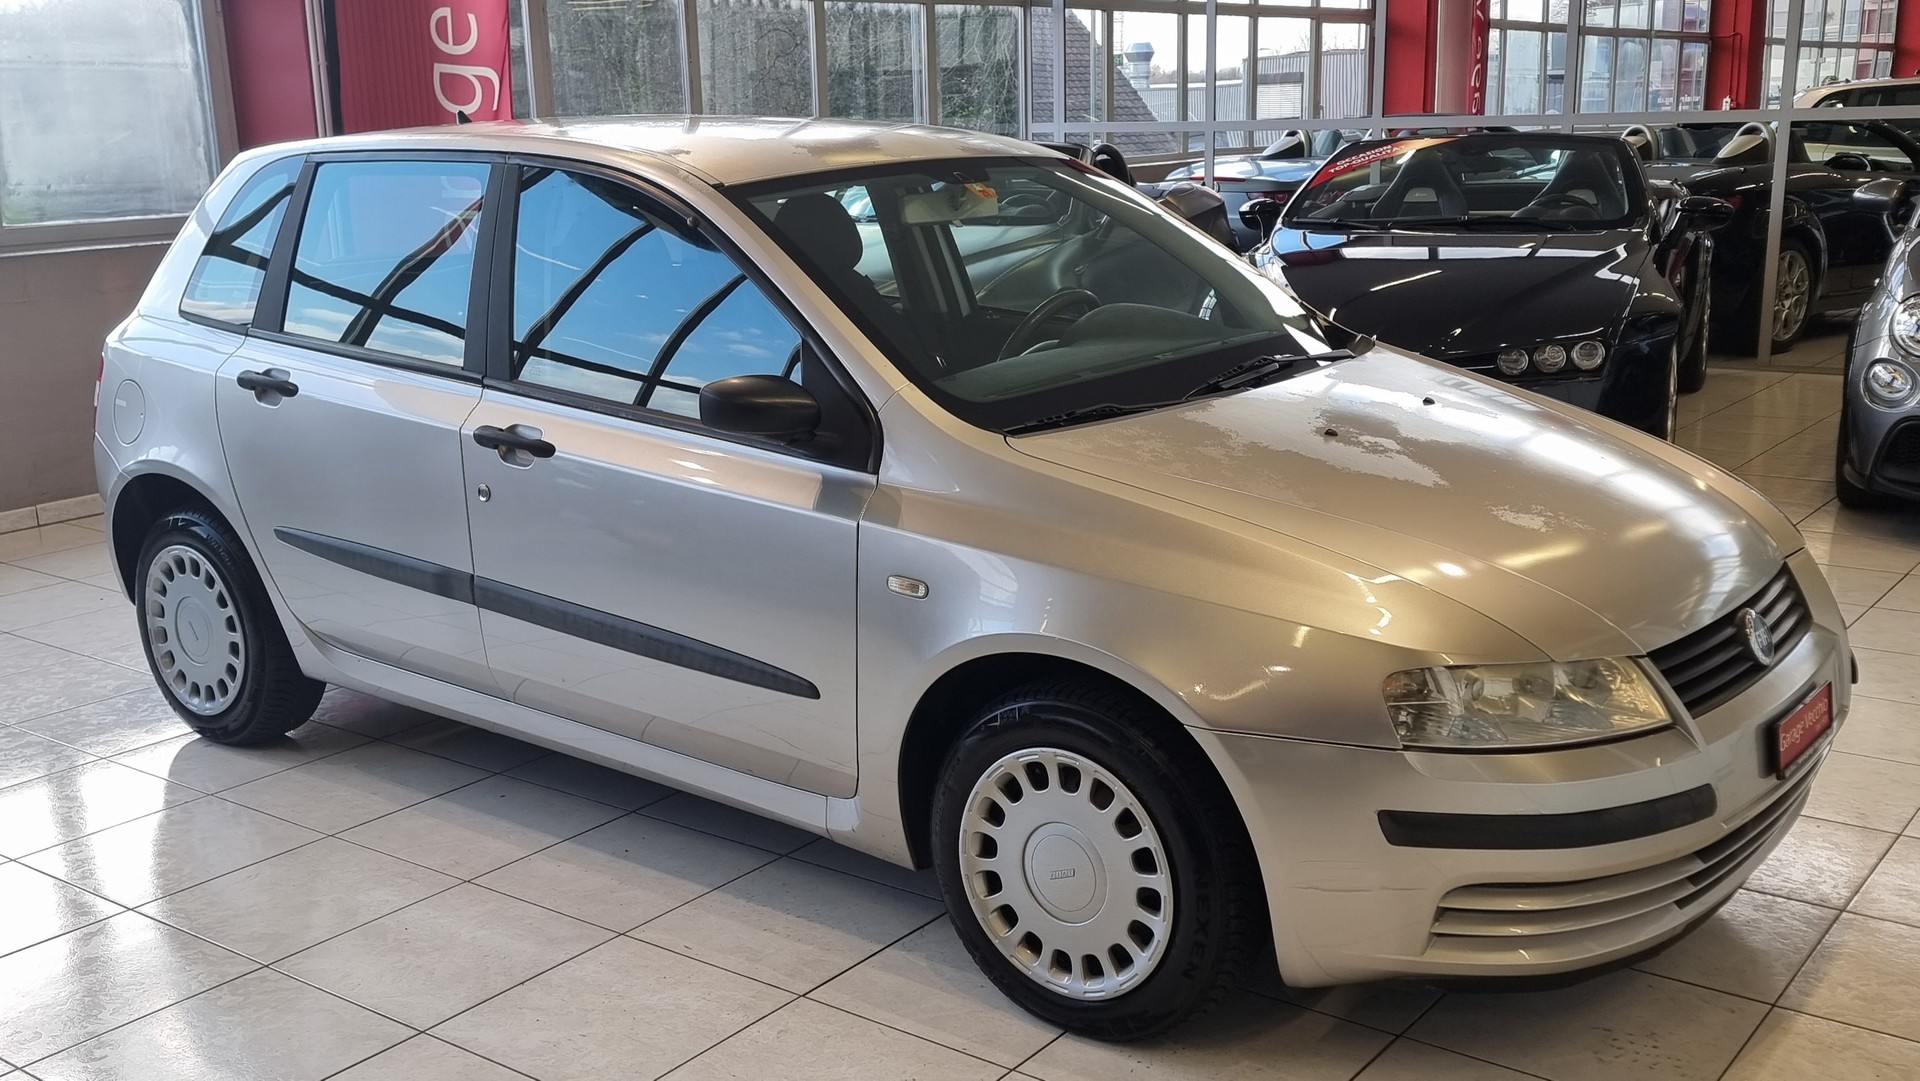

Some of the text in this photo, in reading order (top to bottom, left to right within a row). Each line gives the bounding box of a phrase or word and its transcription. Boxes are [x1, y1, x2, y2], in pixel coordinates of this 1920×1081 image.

[1336, 144, 1393, 166] OCCASION
[1779, 720, 1805, 752] Garage
[1804, 698, 1829, 729] Vecchio
[1050, 868, 1075, 880] FIAT
[1182, 875, 1210, 979] NEXEN
